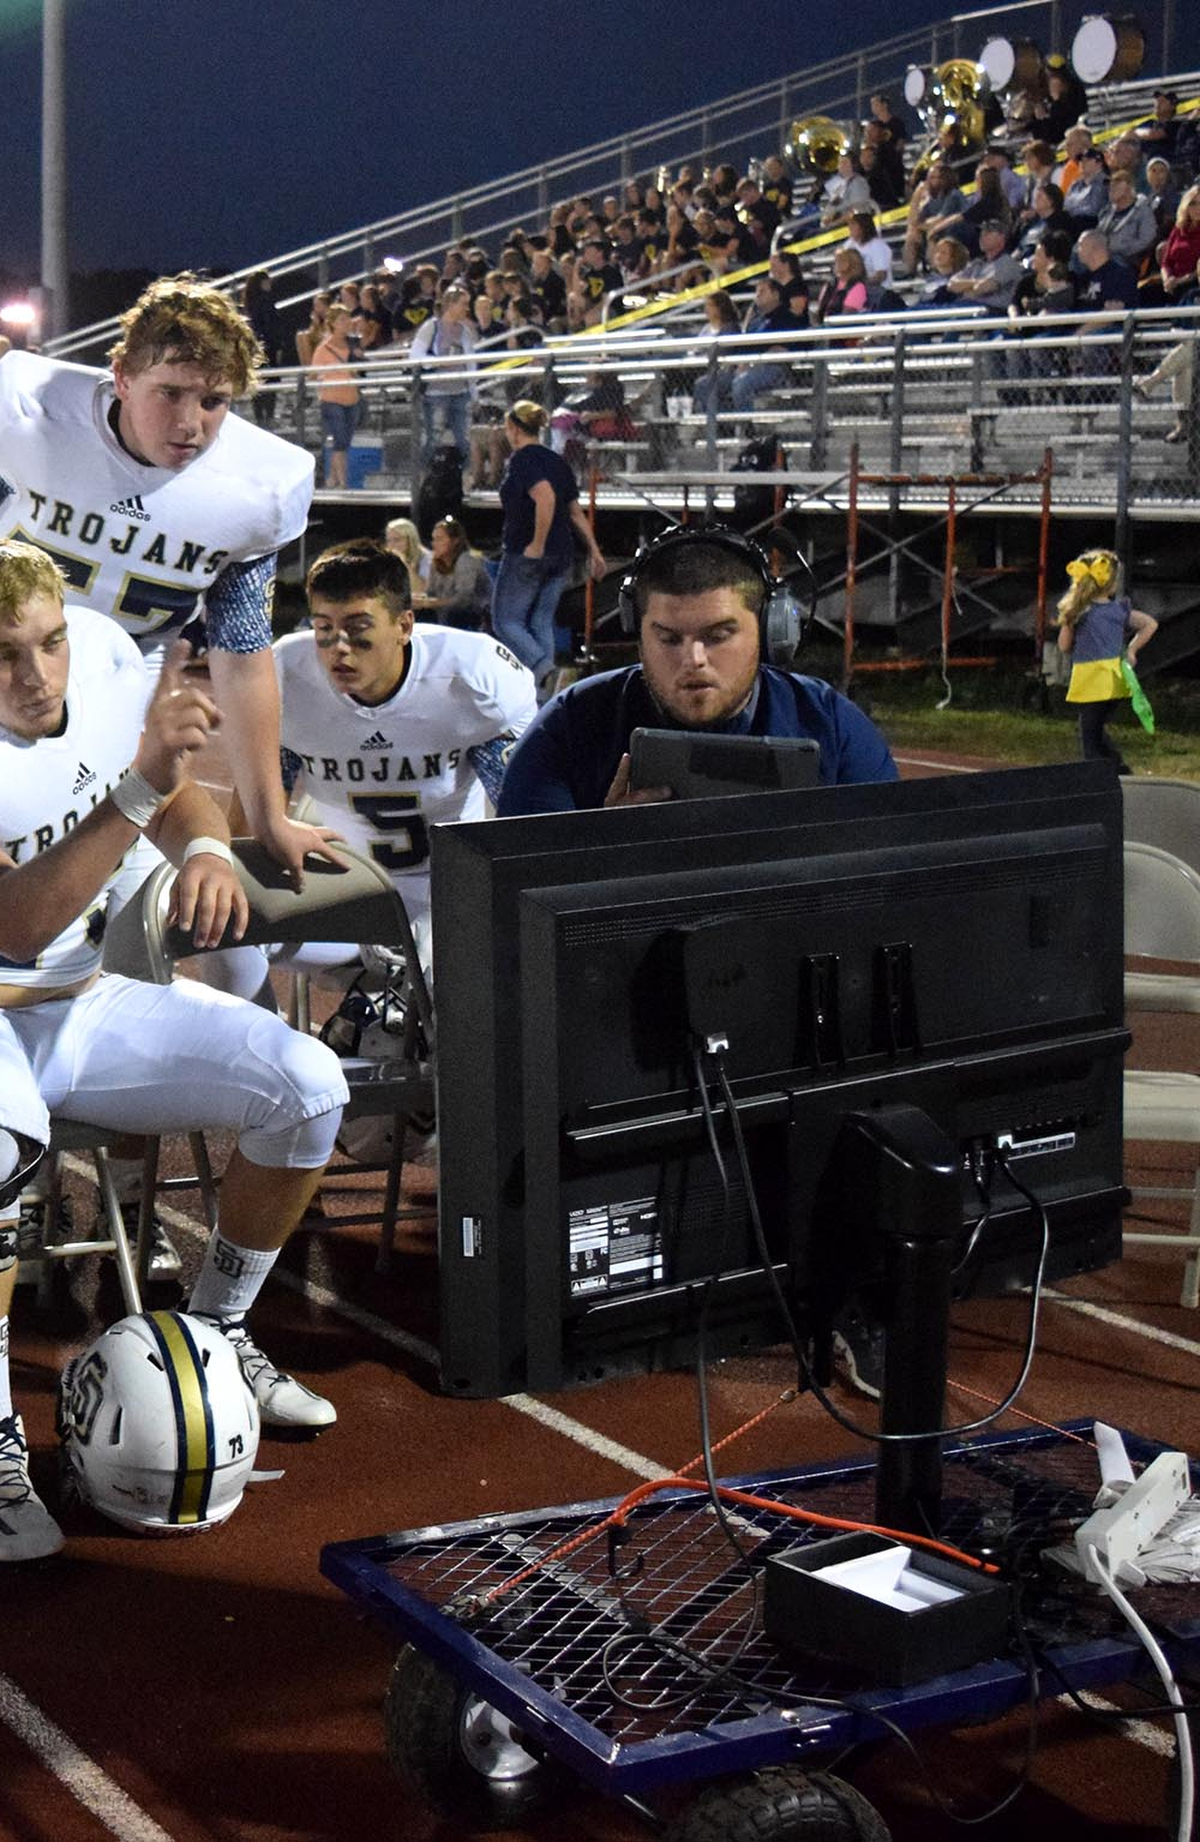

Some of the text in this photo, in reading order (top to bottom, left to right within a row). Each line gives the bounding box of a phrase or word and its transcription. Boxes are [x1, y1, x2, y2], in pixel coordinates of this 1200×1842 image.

[110, 503, 151, 521] adidas
[28, 490, 230, 575] TROJANS
[301, 749, 461, 783] TROJANS
[72, 772, 97, 796] adidas
[347, 791, 429, 869] 5
[228, 1434, 244, 1459] 73
